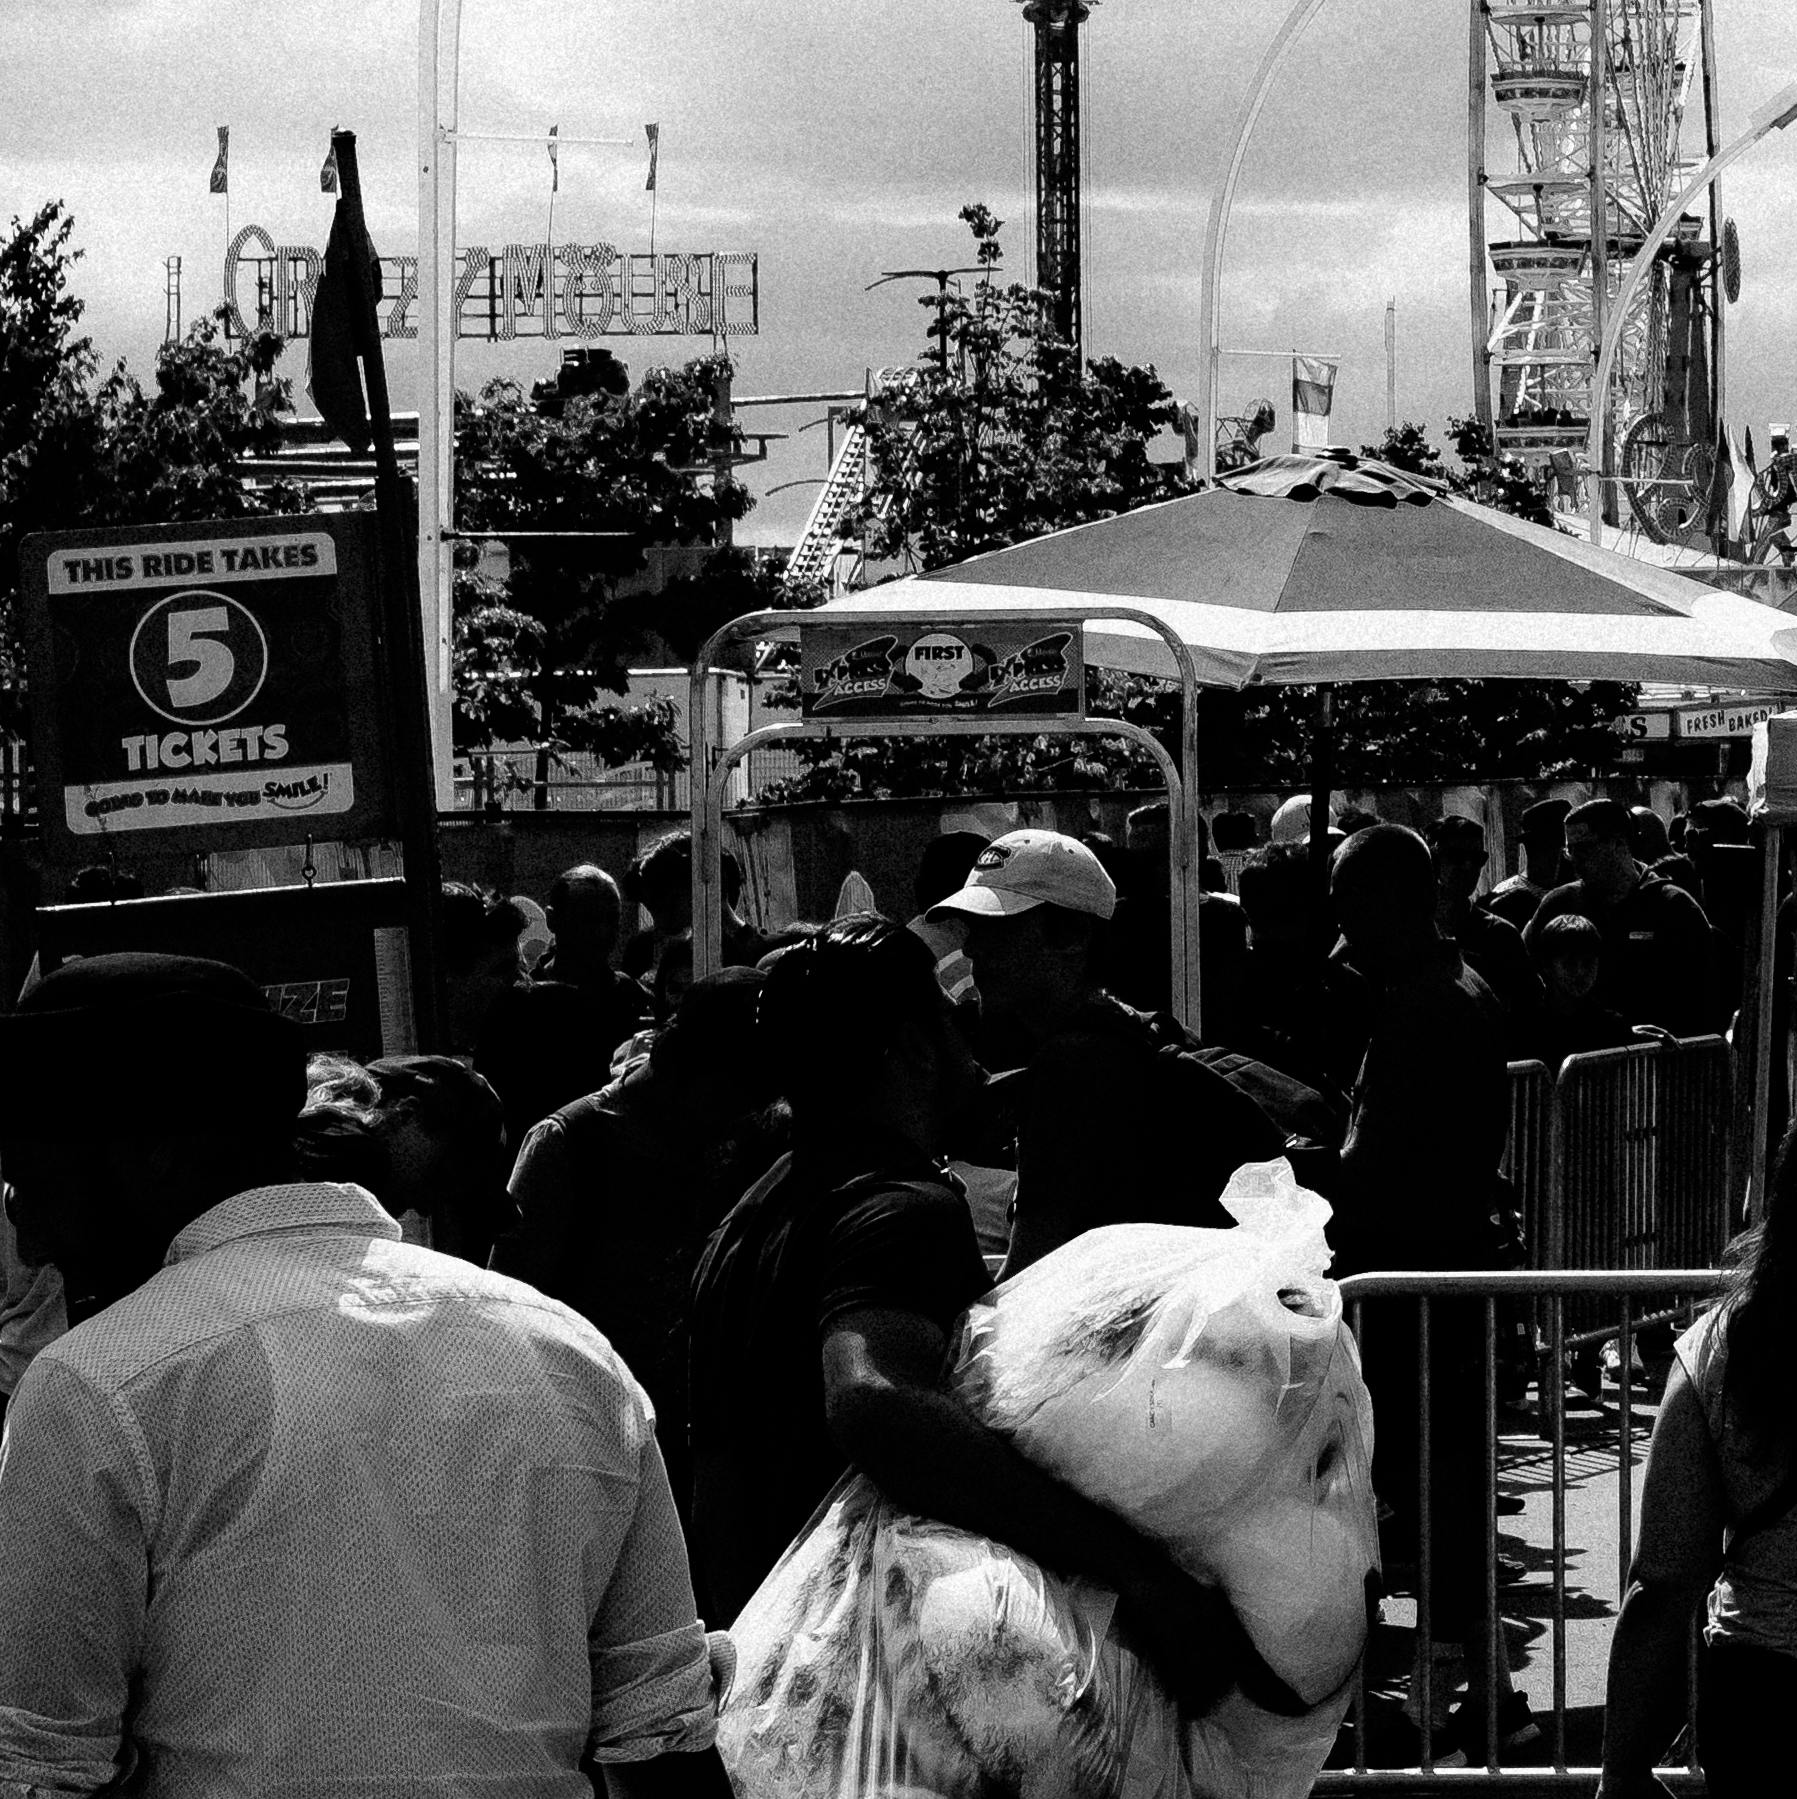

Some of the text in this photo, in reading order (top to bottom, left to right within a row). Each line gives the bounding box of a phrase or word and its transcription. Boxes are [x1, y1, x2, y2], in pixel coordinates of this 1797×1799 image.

[501, 241, 758, 341] MOUSE
[64, 544, 319, 583] THIS RIDE TAKES
[164, 605, 236, 708] 5
[914, 645, 964, 661] FIRST
[834, 677, 888, 696] ACCESS
[1009, 675, 1062, 693] ACCESS
[1686, 710, 1725, 734] FRESH
[121, 722, 290, 772] TICKETS
